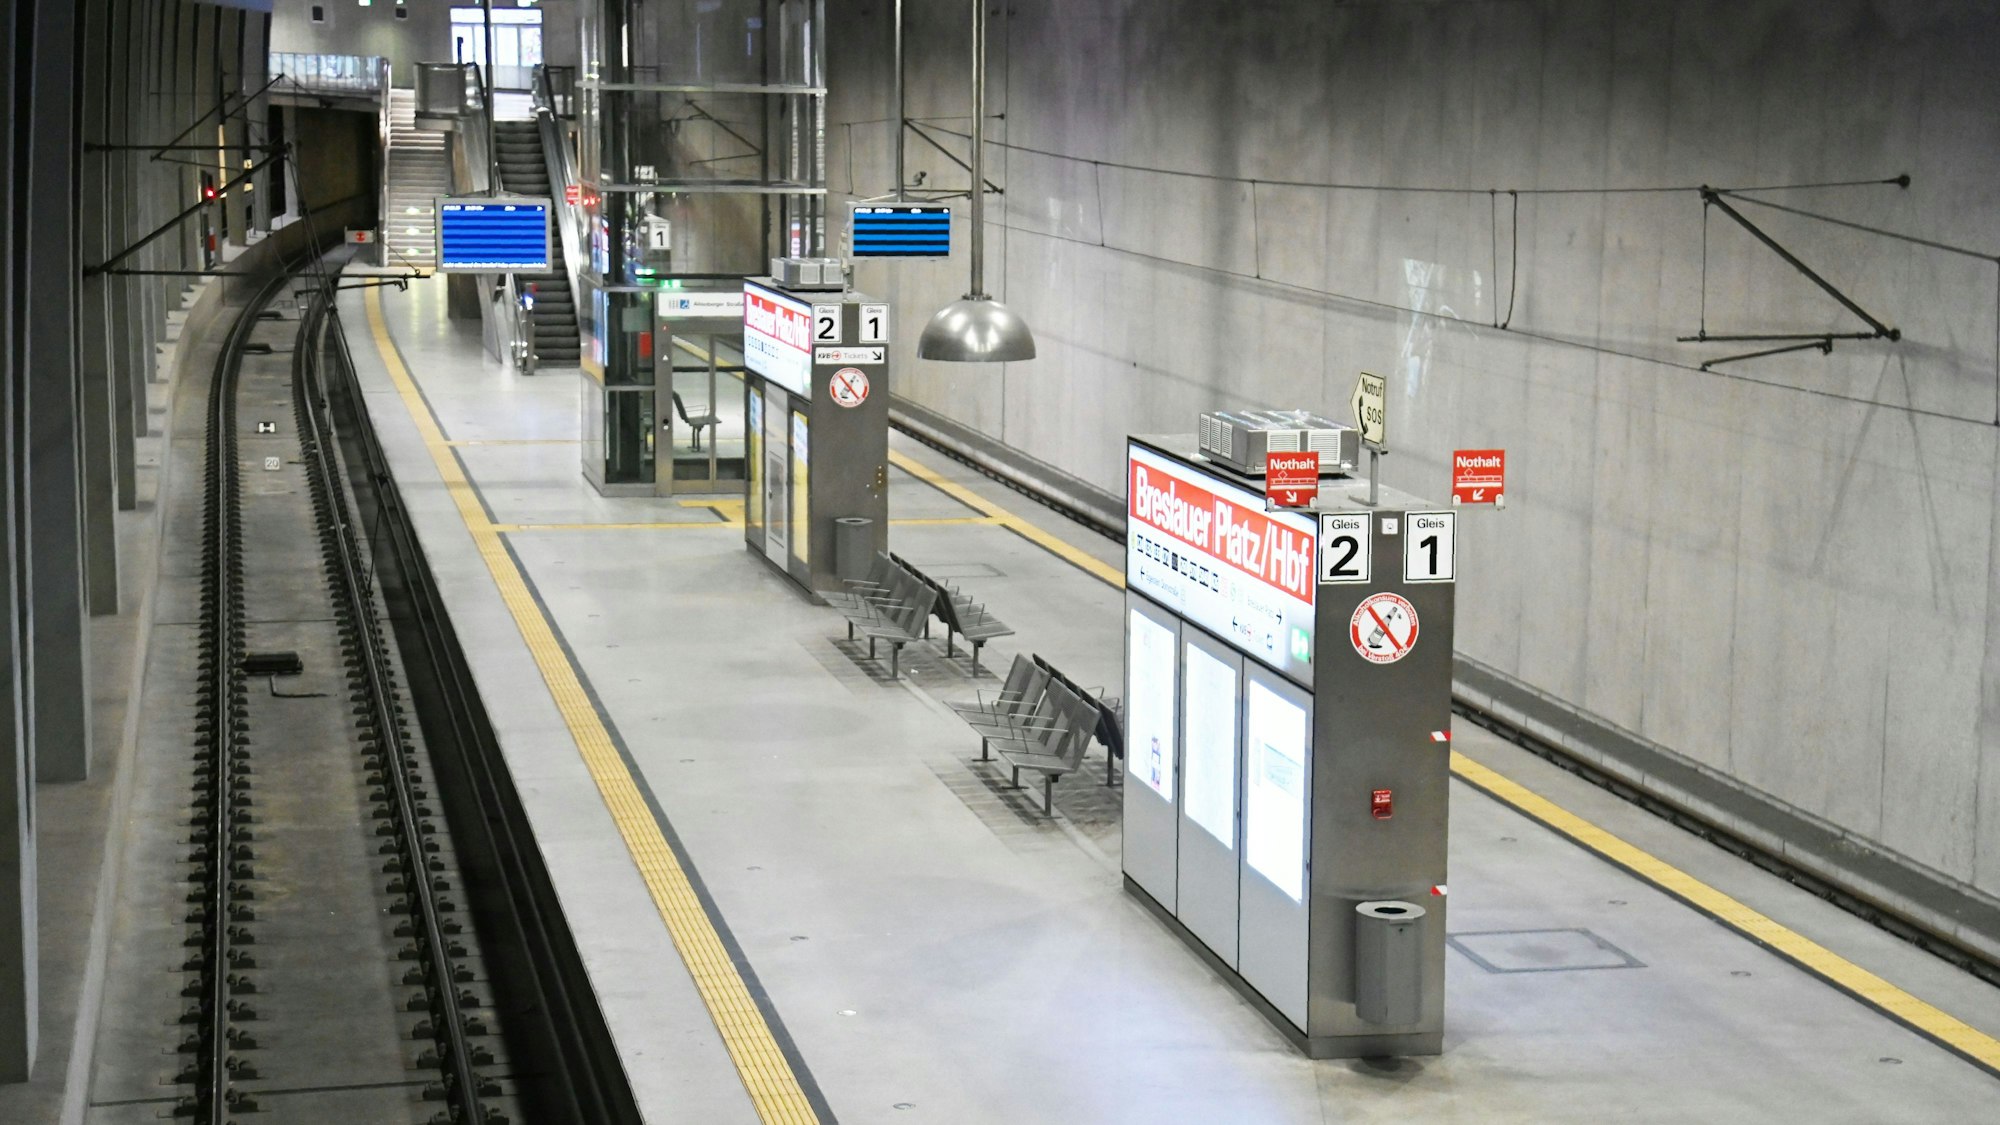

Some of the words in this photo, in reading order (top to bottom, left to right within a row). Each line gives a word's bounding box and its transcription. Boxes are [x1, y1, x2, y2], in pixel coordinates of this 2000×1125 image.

[656, 231, 664, 246] 1
[818, 317, 835, 339] 2
[868, 317, 879, 339] 1
[1361, 377, 1383, 398] Notruf
[1366, 405, 1382, 425] SOS
[266, 459, 279, 468] 20
[1270, 458, 1315, 470] Nothalt
[1456, 455, 1501, 468] Nothalt
[1135, 469, 1213, 550] Breslauer
[1214, 504, 1310, 597] Platz/Hbf
[1332, 519, 1360, 530] Gleis
[1417, 518, 1445, 530] Gleis
[1329, 535, 1360, 577] 2
[1419, 535, 1438, 575] 1
[1353, 595, 1397, 626] Alkoholkonsum
[1397, 598, 1417, 626] verboten
[1358, 645, 1368, 656] bei
[1367, 650, 1395, 662] Verstoß
